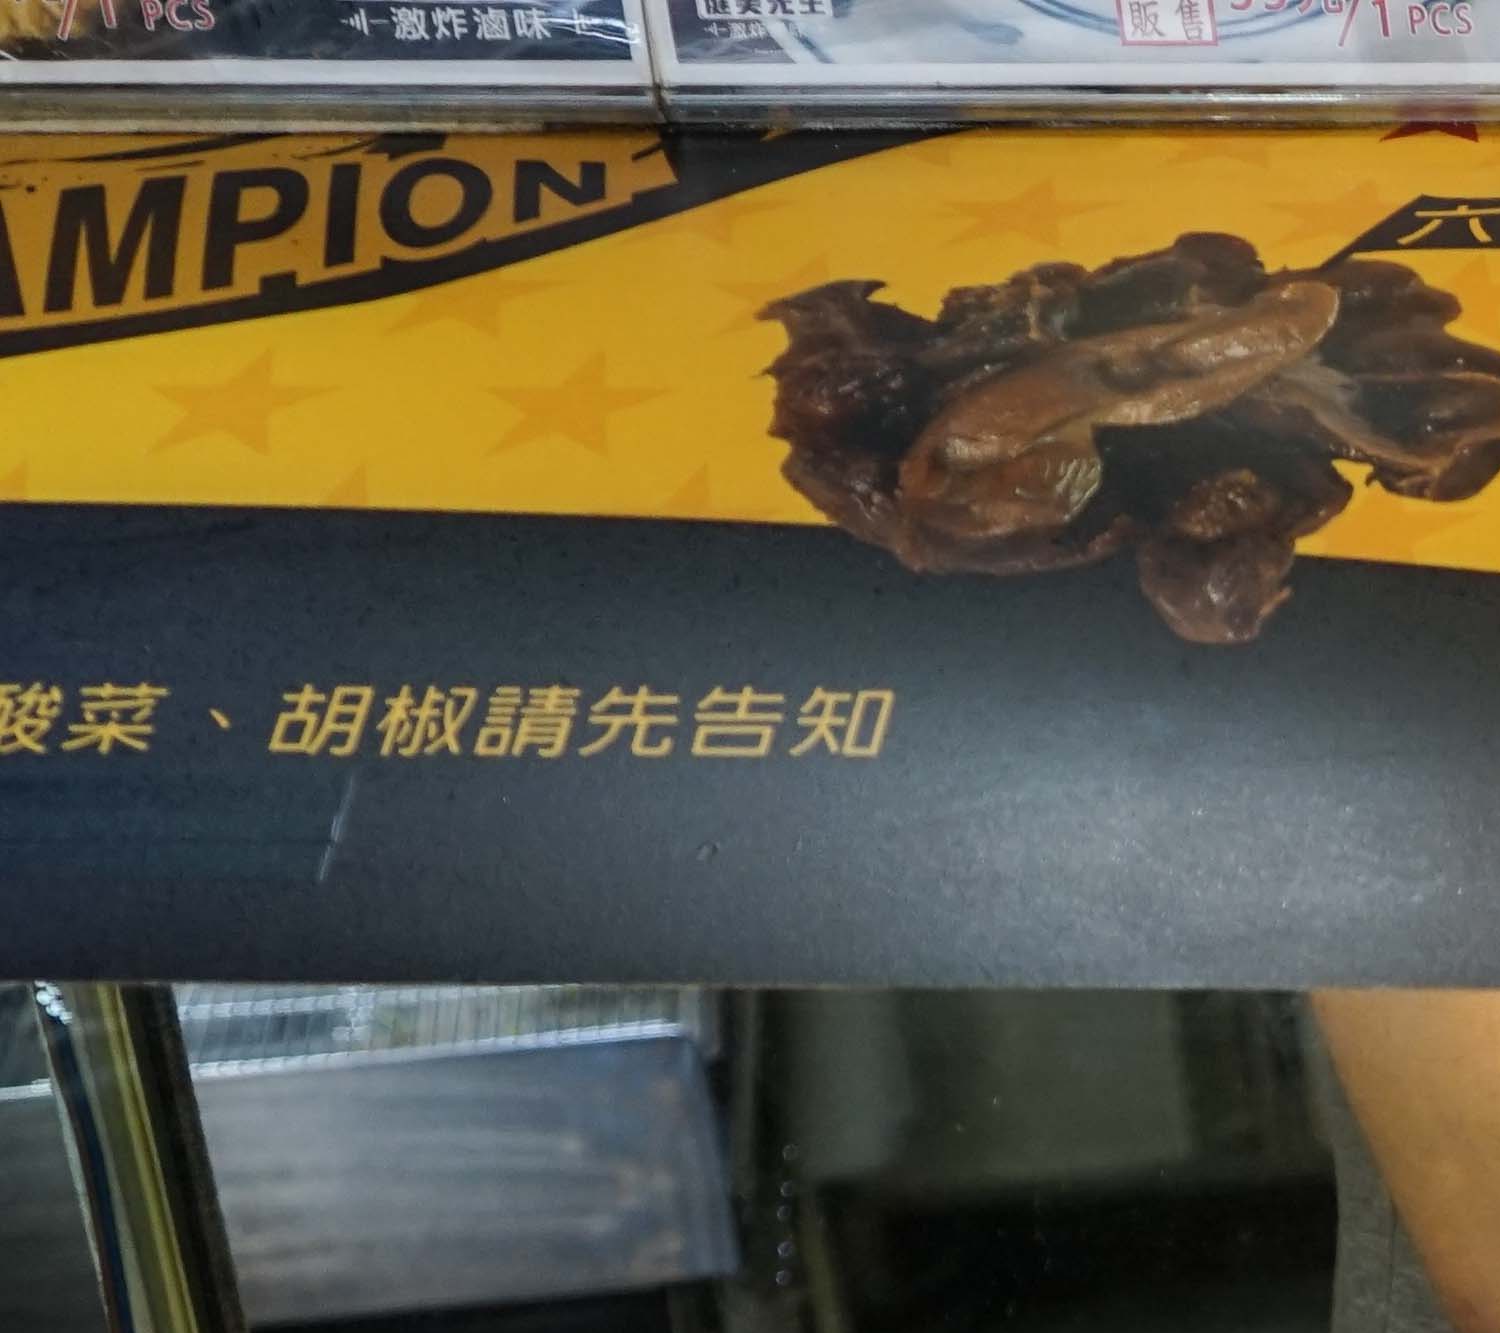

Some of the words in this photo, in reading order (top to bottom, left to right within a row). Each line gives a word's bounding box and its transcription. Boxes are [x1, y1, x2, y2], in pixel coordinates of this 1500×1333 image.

[391, 6, 553, 41] 激炸滷味
[1407, 3, 1475, 36] PCS
[0, 158, 607, 316] MPION
